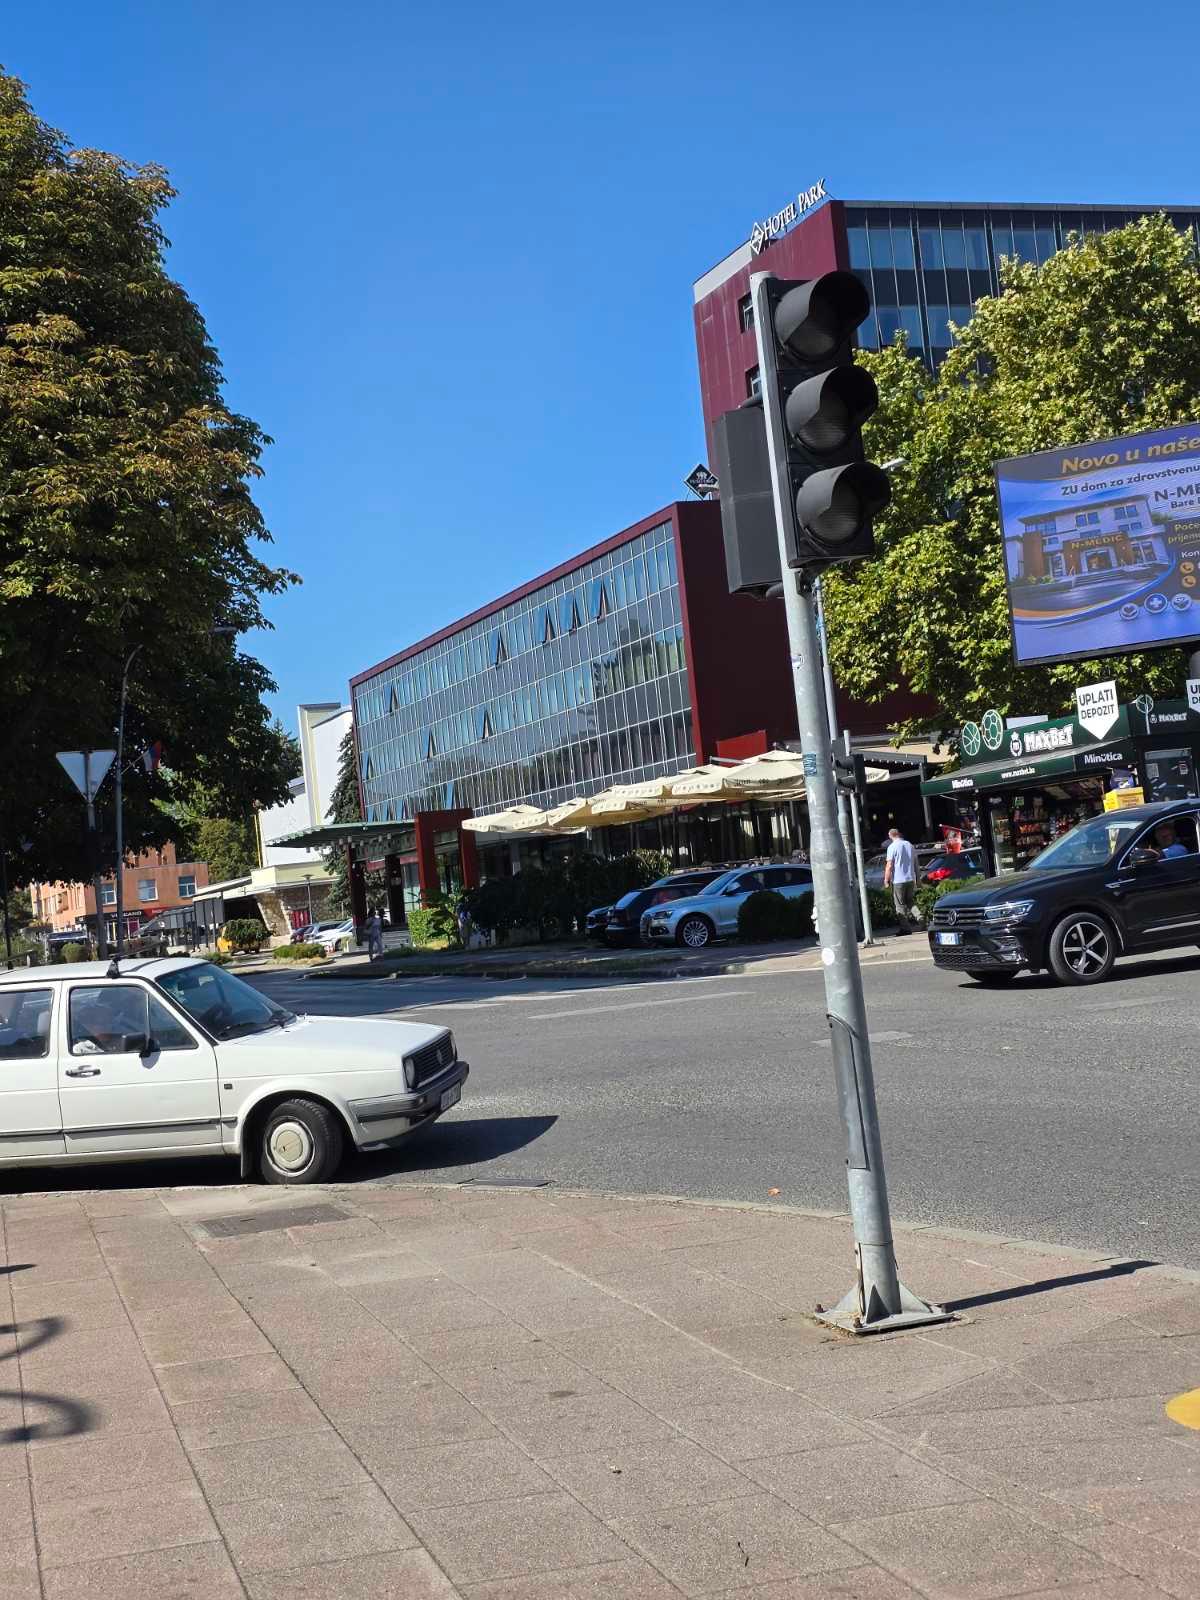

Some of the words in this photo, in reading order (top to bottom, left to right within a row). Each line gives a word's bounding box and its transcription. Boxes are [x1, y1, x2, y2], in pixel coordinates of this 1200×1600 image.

[763, 201, 797, 240] HOTEL
[798, 177, 827, 213] PARK
[1062, 453, 1120, 473] Novo
[1125, 449, 1139, 461] u
[1062, 485, 1078, 496] ZU
[1081, 482, 1107, 493] dom
[1127, 465, 1200, 484] zdravstvenu
[1079, 689, 1114, 706] UPLATI
[1081, 704, 1115, 719] DEPOZIT
[1024, 724, 1073, 753] MAXBET
